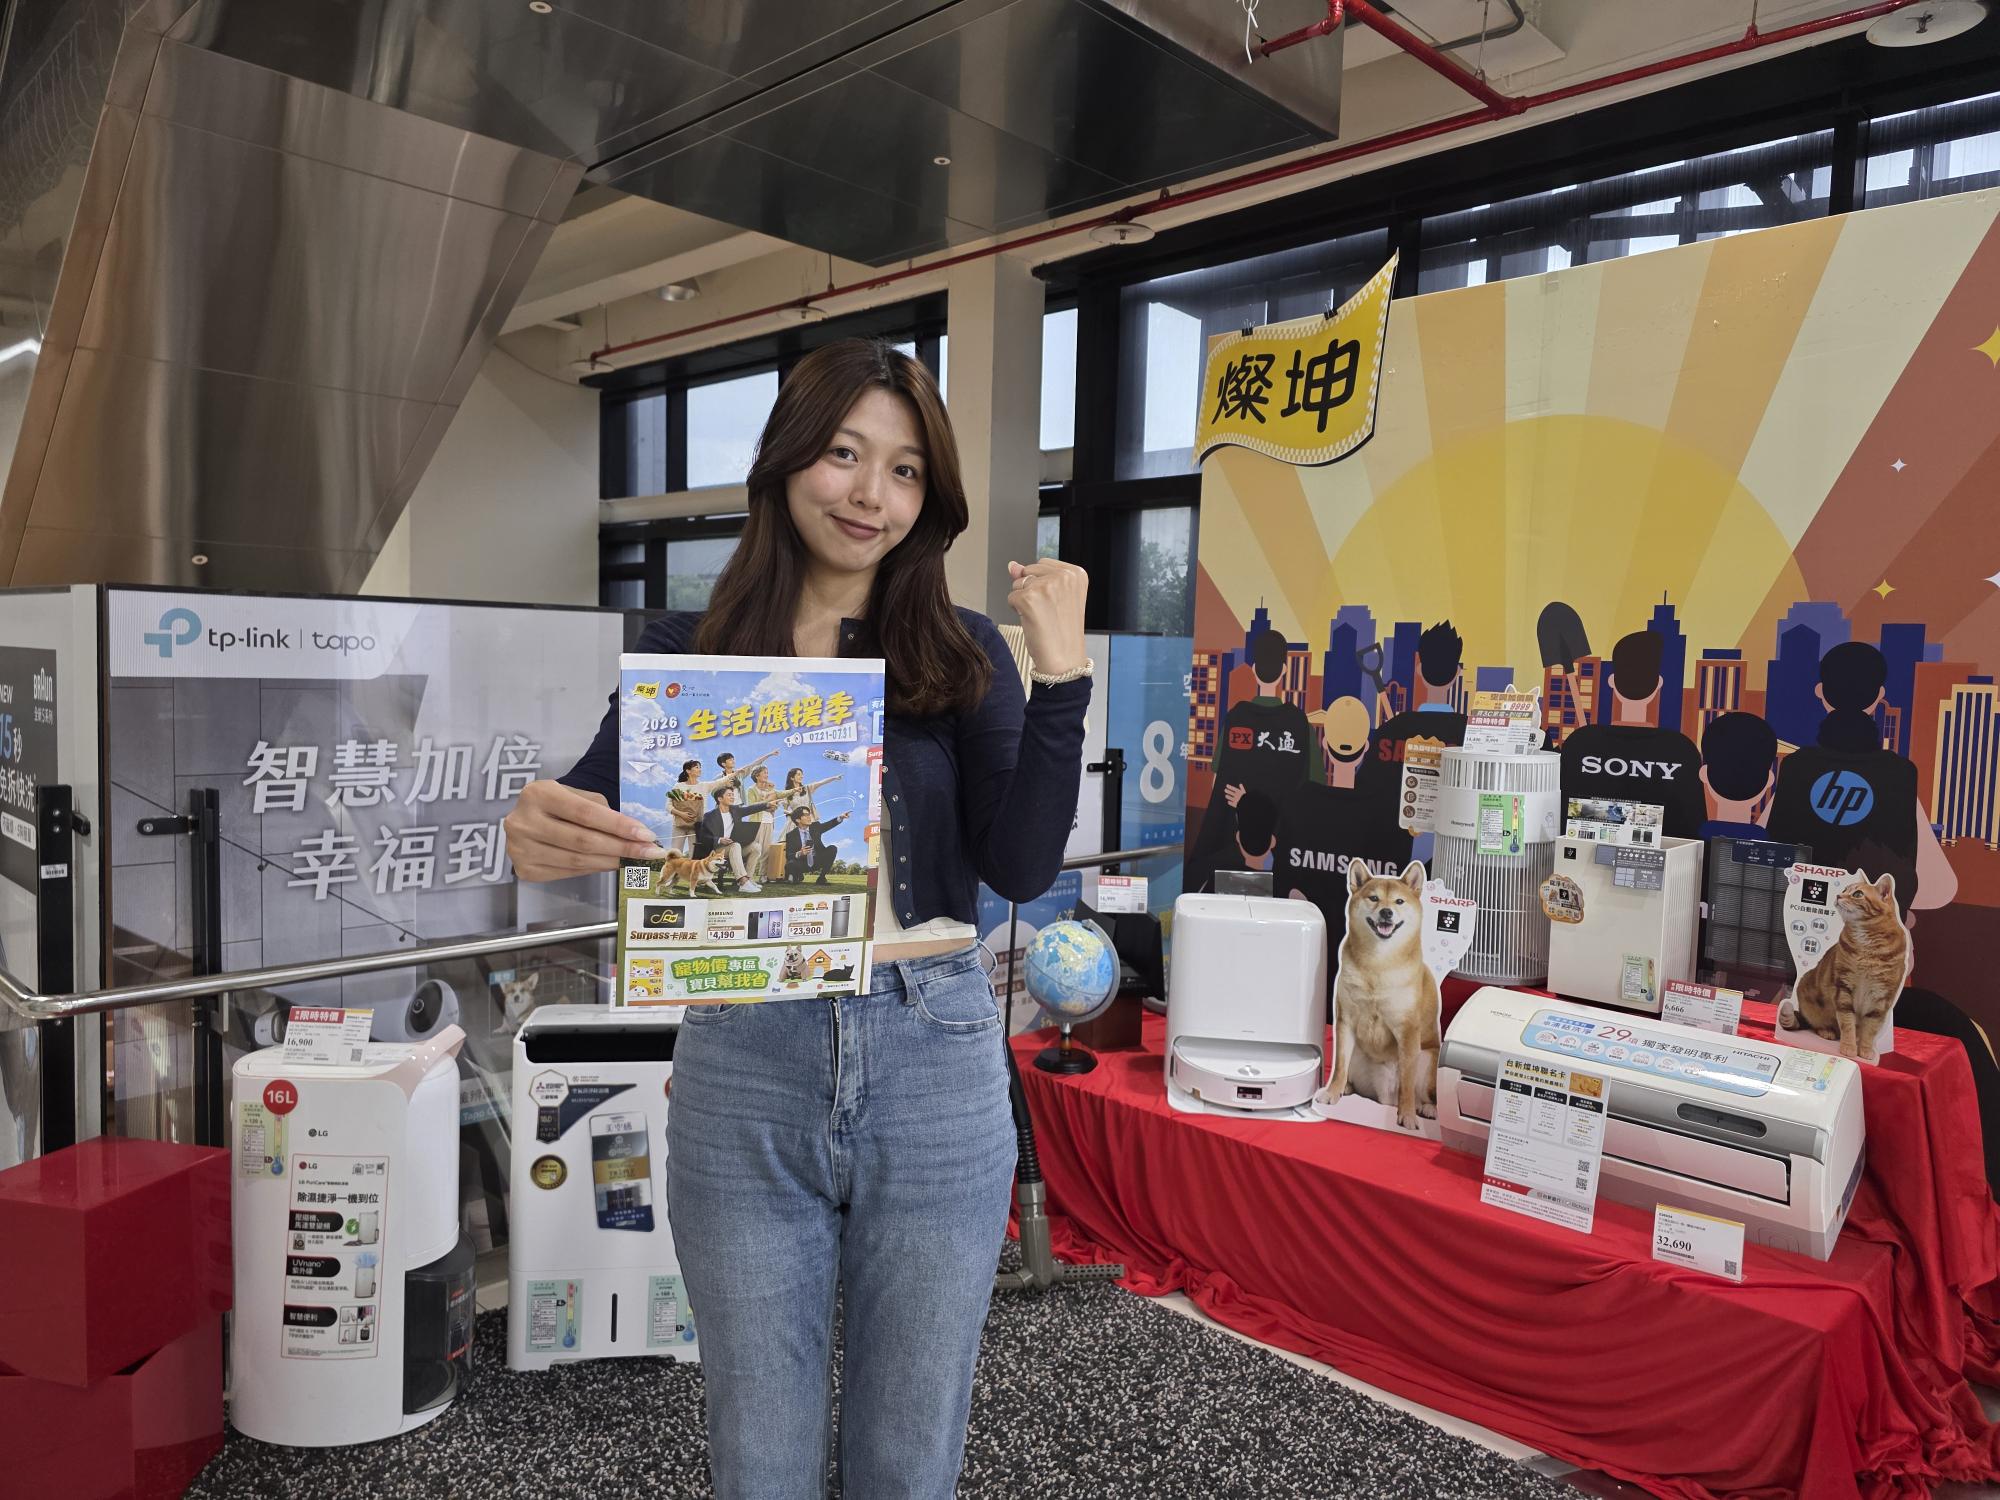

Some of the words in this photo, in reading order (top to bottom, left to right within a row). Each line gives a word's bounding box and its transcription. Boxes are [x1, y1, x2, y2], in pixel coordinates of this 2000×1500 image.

[1211, 339, 1361, 433] 燦坤
[208, 627, 290, 652] tp-link
[312, 631, 375, 656] tapo
[641, 716, 678, 733] 2026
[686, 691, 855, 742] 生活應援季
[642, 732, 682, 750] 第6屆
[1231, 732, 1252, 745] PX
[1257, 731, 1300, 754] 大通
[1140, 720, 1175, 803] 8
[1581, 756, 1682, 780] SONY
[243, 735, 542, 814] 智慧加倍
[1818, 773, 1871, 826] hp
[287, 818, 507, 900] 幸福到
[1289, 847, 1398, 877] SAMSNG
[1794, 864, 1846, 878] SHARP
[1430, 896, 1475, 908] SHARP
[630, 930, 697, 941] Surpass卡限定
[674, 958, 757, 977] 寵物價專區
[689, 972, 768, 992] 寶貝幫我省
[1664, 1003, 1685, 1013] 6,666
[287, 1037, 313, 1047] 16,900
[1597, 1026, 1633, 1041] 29
[1641, 1039, 1729, 1064] 獨家發明專利
[1732, 1050, 1770, 1061] HITACHI
[267, 1091, 294, 1104] 16L
[1656, 1235, 1692, 1252] 32,690
